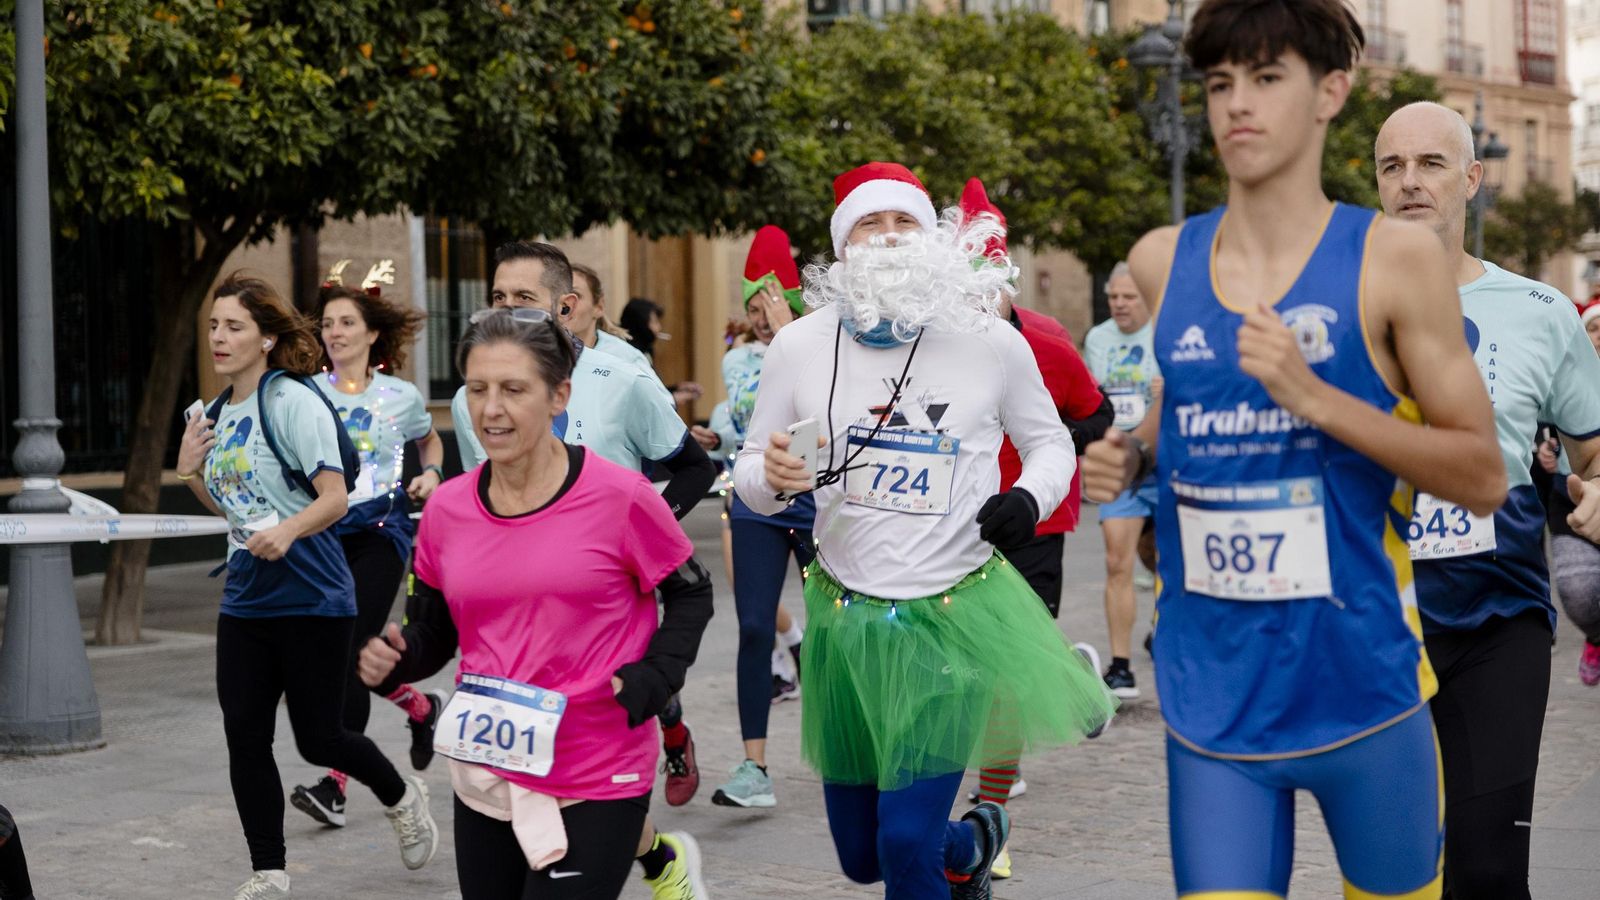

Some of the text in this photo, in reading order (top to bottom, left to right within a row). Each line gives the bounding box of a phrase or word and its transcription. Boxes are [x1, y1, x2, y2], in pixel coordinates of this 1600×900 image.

[871, 463, 930, 496] 724
[1407, 505, 1472, 541] 643
[1205, 532, 1285, 573] 687
[456, 709, 537, 755] 1201
